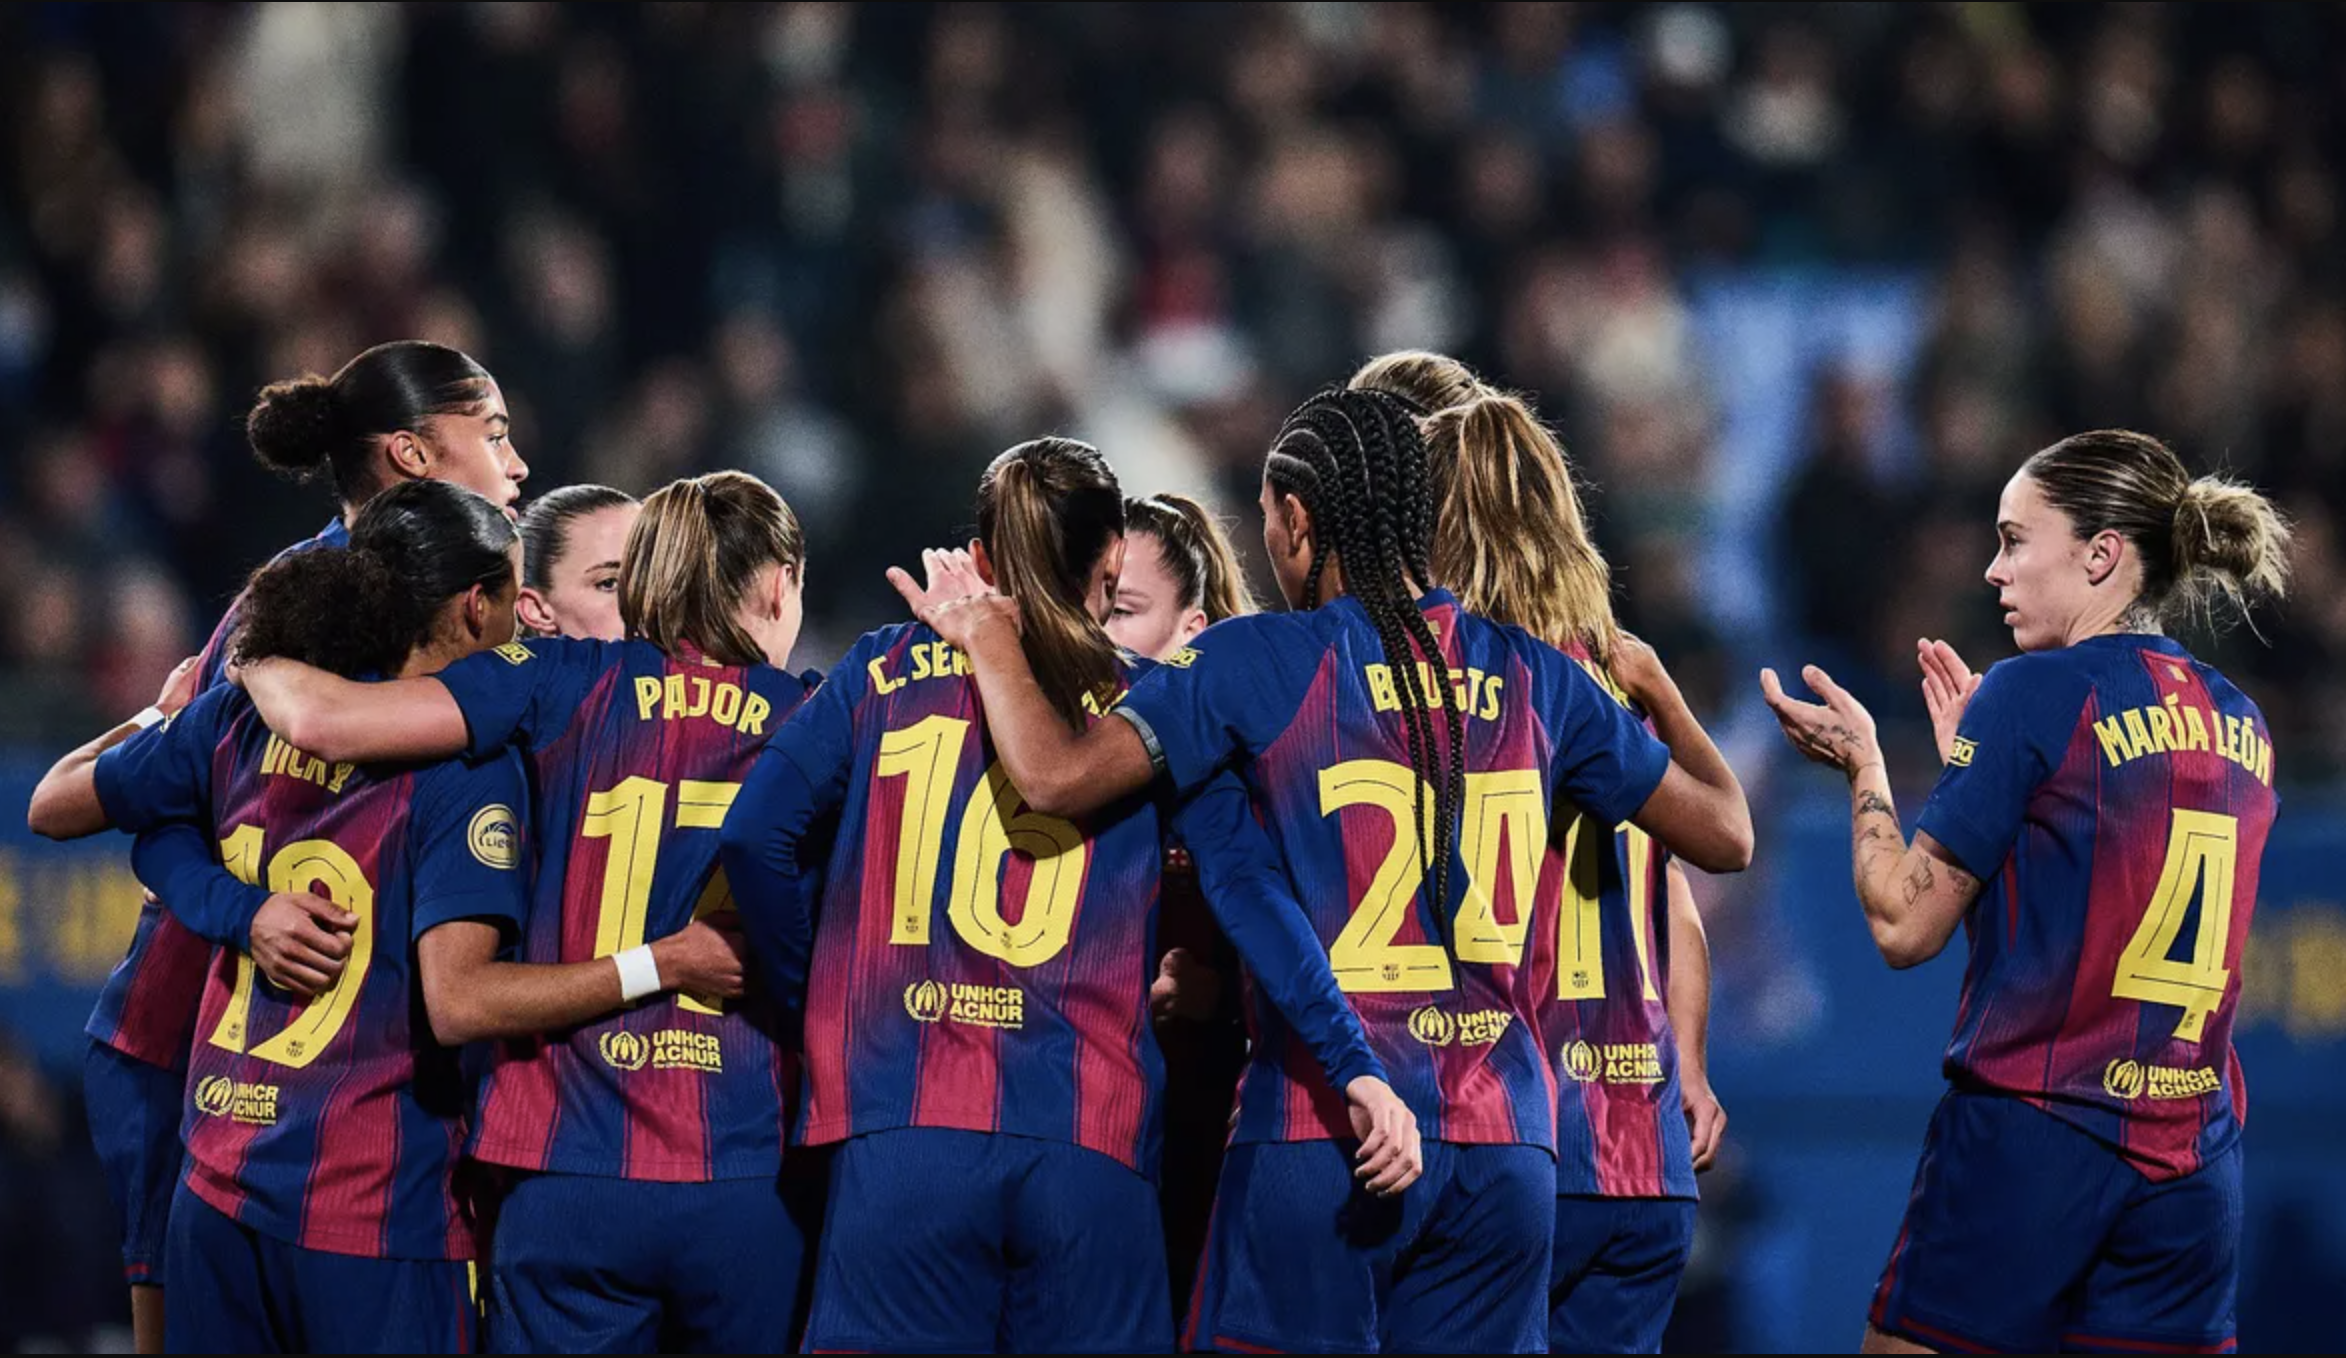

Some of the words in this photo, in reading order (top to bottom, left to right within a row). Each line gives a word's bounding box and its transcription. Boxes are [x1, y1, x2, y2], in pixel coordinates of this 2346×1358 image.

[867, 655, 907, 695] C.
[634, 673, 771, 736] PAJOR
[2093, 691, 2210, 768] MARÍA
[2211, 709, 2272, 788] LEÓN
[877, 713, 1094, 968] 16
[207, 822, 374, 1070] 19
[2110, 808, 2238, 1044] 4
[949, 1000, 1024, 1022] ACNUR
[951, 983, 1024, 1005] UNHCR
[651, 1045, 723, 1067] ACNUR
[652, 1029, 721, 1052] UNHCR
[2147, 1065, 2215, 1084] UNHCR
